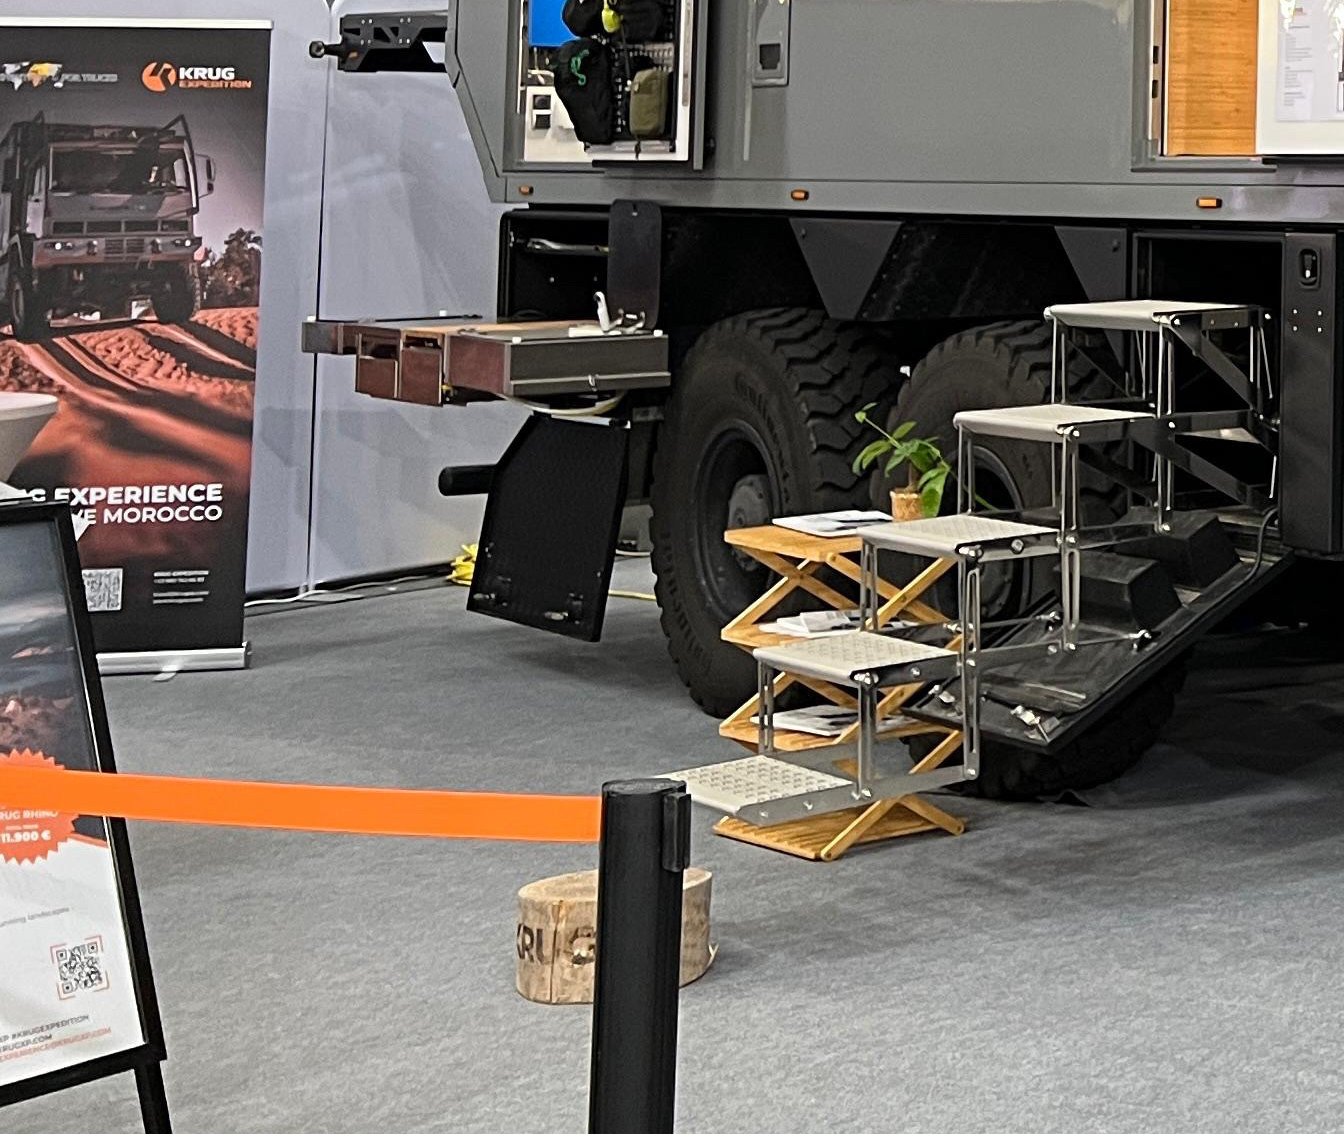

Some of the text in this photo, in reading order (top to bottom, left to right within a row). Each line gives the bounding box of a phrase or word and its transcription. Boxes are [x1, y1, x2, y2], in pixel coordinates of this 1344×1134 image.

[179, 67, 235, 80] KRUG
[54, 484, 223, 505] EXPERIENCE
[103, 505, 223, 524] MOROCCO
[0, 809, 20, 820] RUG
